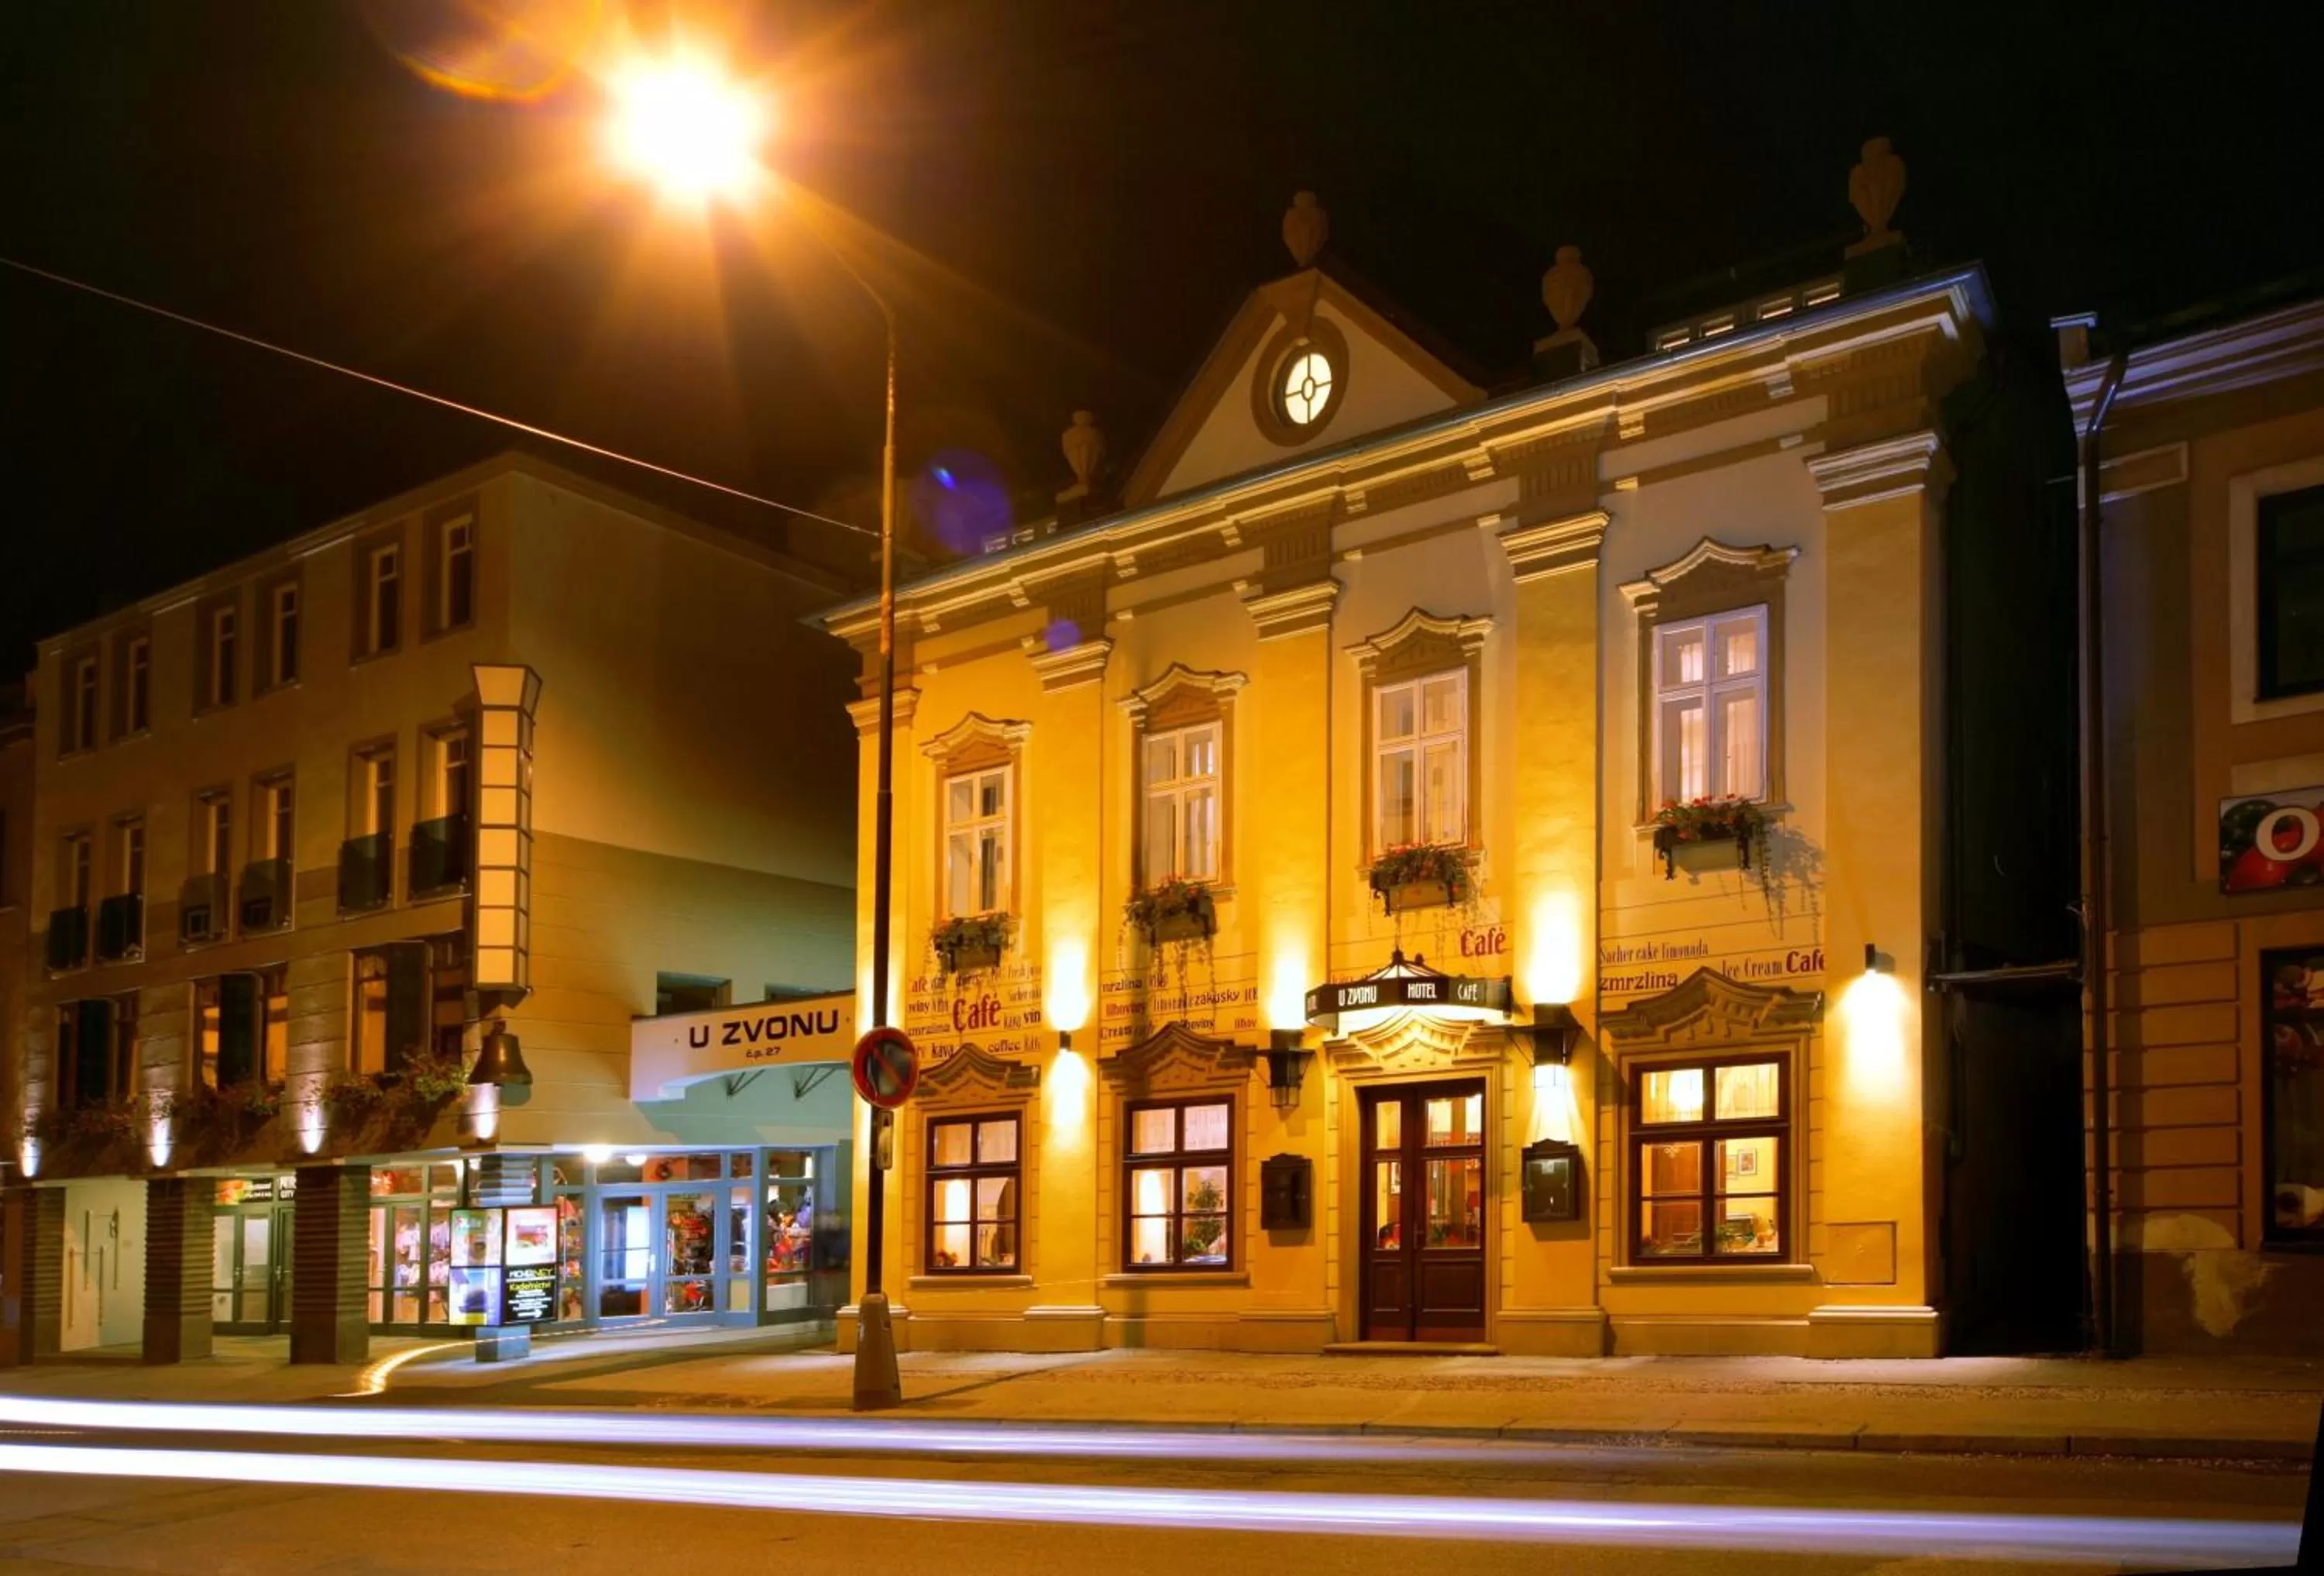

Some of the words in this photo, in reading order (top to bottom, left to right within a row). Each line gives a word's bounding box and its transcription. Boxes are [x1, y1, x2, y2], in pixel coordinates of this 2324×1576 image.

[1460, 927, 1506, 957] Café
[1408, 982, 1437, 1000] HOTEL
[1600, 971, 1678, 991] zmrzlina
[1338, 989, 1346, 1007] U
[1347, 985, 1377, 1005] ZVONU
[952, 992, 1002, 1032] Café
[689, 1024, 710, 1048] U
[721, 1009, 838, 1045] ZVONU
[765, 1047, 782, 1057] 27
